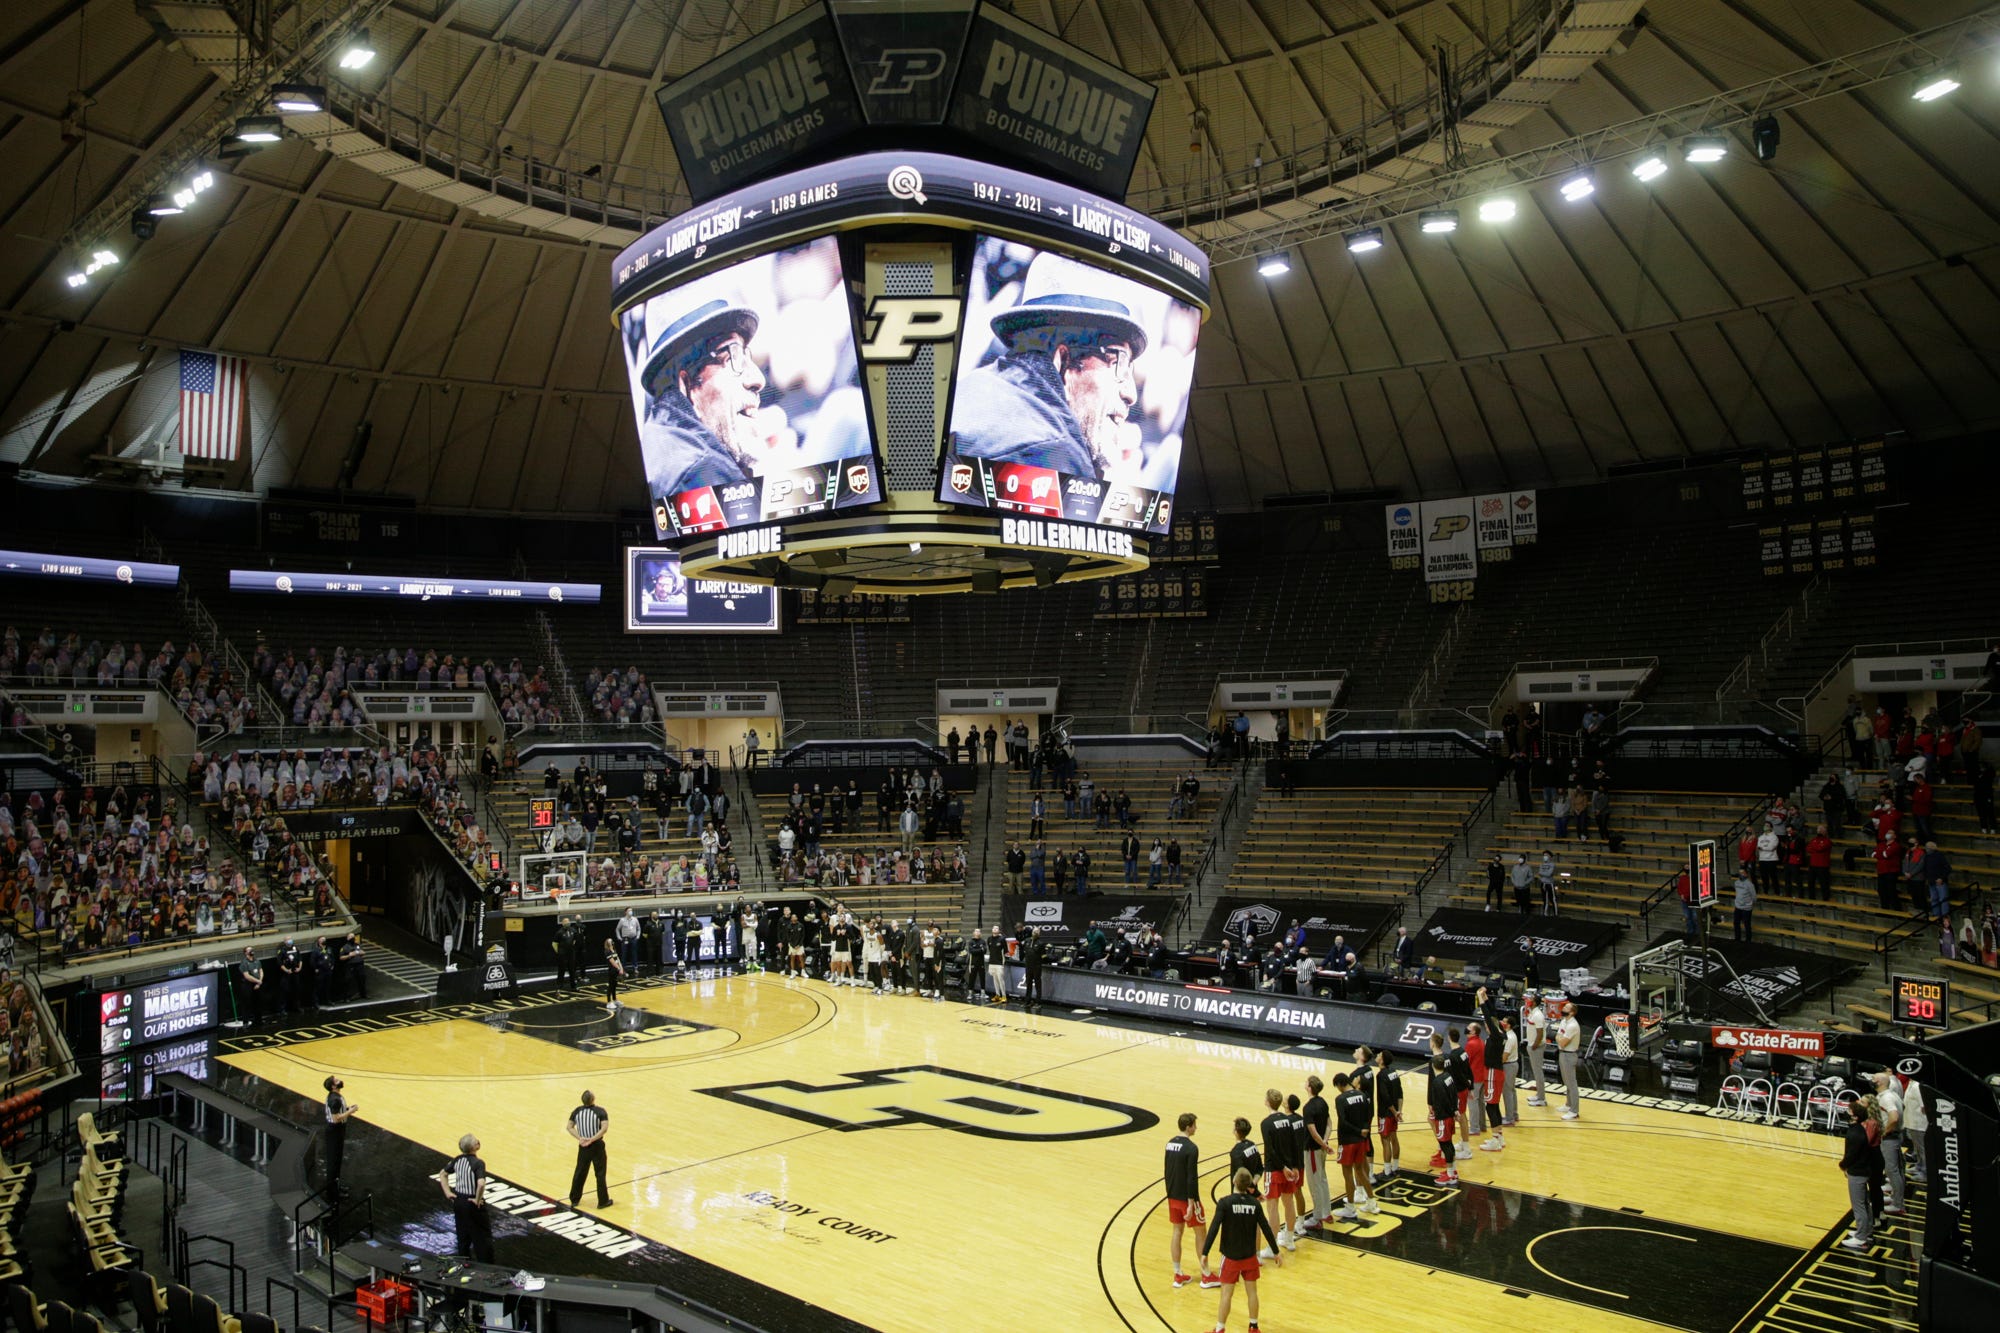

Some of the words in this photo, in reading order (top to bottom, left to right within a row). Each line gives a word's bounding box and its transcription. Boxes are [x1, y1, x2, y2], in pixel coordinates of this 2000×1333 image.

[867, 48, 947, 95] P
[680, 39, 830, 159] PURDUE
[978, 39, 1134, 156] PURDUE
[709, 108, 825, 175] BOILERMAKERS
[986, 108, 1105, 171] BOILERMAKERS
[771, 195, 796, 215] 1,189
[800, 182, 838, 206] GAMES
[973, 182, 1001, 202] 1947
[1015, 192, 1041, 213] 2021
[666, 222, 699, 258] LARRY
[699, 206, 742, 243] CLISBY
[1072, 204, 1112, 238] LARRY
[1113, 219, 1151, 254] CLISBY
[1183, 256, 1201, 279] GAMES
[861, 298, 961, 359] P
[803, 477, 815, 495] 0
[849, 473, 868, 491] ups
[952, 471, 971, 488] ups
[1006, 474, 1019, 493] 0
[722, 483, 755, 502] 20:00
[1067, 479, 1100, 498] 20:00
[681, 502, 690, 519] 0
[1134, 497, 1142, 513] 0
[318, 511, 361, 527] PAINT
[1480, 519, 1509, 531] FINAL
[1516, 513, 1533, 524] NIT
[319, 526, 361, 541] CREW
[1002, 518, 1134, 558] BOILERMAKERS
[1174, 527, 1193, 542] 55
[1200, 525, 1215, 541] 13
[1390, 528, 1418, 540] FINAL
[1482, 530, 1508, 542] FOUR
[1515, 534, 1537, 545] 1974
[718, 526, 781, 560] PURDUE
[1392, 539, 1417, 550] FOUR
[1391, 555, 1420, 571] 1969
[1430, 553, 1470, 564] NATIONAL
[1480, 547, 1512, 563] 1980
[59, 565, 83, 575] GAMES
[1428, 562, 1474, 573] CHAMPIONS
[695, 580, 726, 594] LARRY
[1117, 584, 1137, 599] 25
[1140, 583, 1160, 598] 33
[1163, 582, 1183, 597] 50
[1429, 580, 1475, 604] 1932
[800, 590, 816, 604] 19
[534, 810, 551, 827] 30
[324, 831, 337, 839] TO
[341, 829, 368, 838] PLAY
[371, 826, 400, 836] HARD
[143, 988, 160, 998] THIS
[162, 986, 169, 995] IS
[483, 980, 510, 991] PIONEER
[1725, 980, 1776, 1000] FEDERAL
[1900, 982, 1941, 1000] 20:00
[123, 994, 132, 1006] 0
[144, 986, 208, 1019] MACKEY
[1095, 984, 1169, 1007] WELCOME
[1172, 994, 1191, 1010] TO
[1194, 998, 1264, 1021] MACKEY
[1266, 1007, 1326, 1029] ARENA
[1908, 998, 1934, 1019] 30
[108, 1016, 128, 1026] 20:00
[144, 1022, 167, 1038] OUR
[169, 1012, 208, 1032] HOUSE
[123, 1028, 131, 1040] 0
[1013, 1026, 1067, 1039] COURT
[1399, 1022, 1435, 1044] P
[1939, 1135, 1960, 1211] Anthem
[743, 1190, 819, 1216] KEADY
[818, 1216, 898, 1245] COURT
[1232, 1204, 1256, 1215] UNITY
[530, 1211, 648, 1259] ARENA
